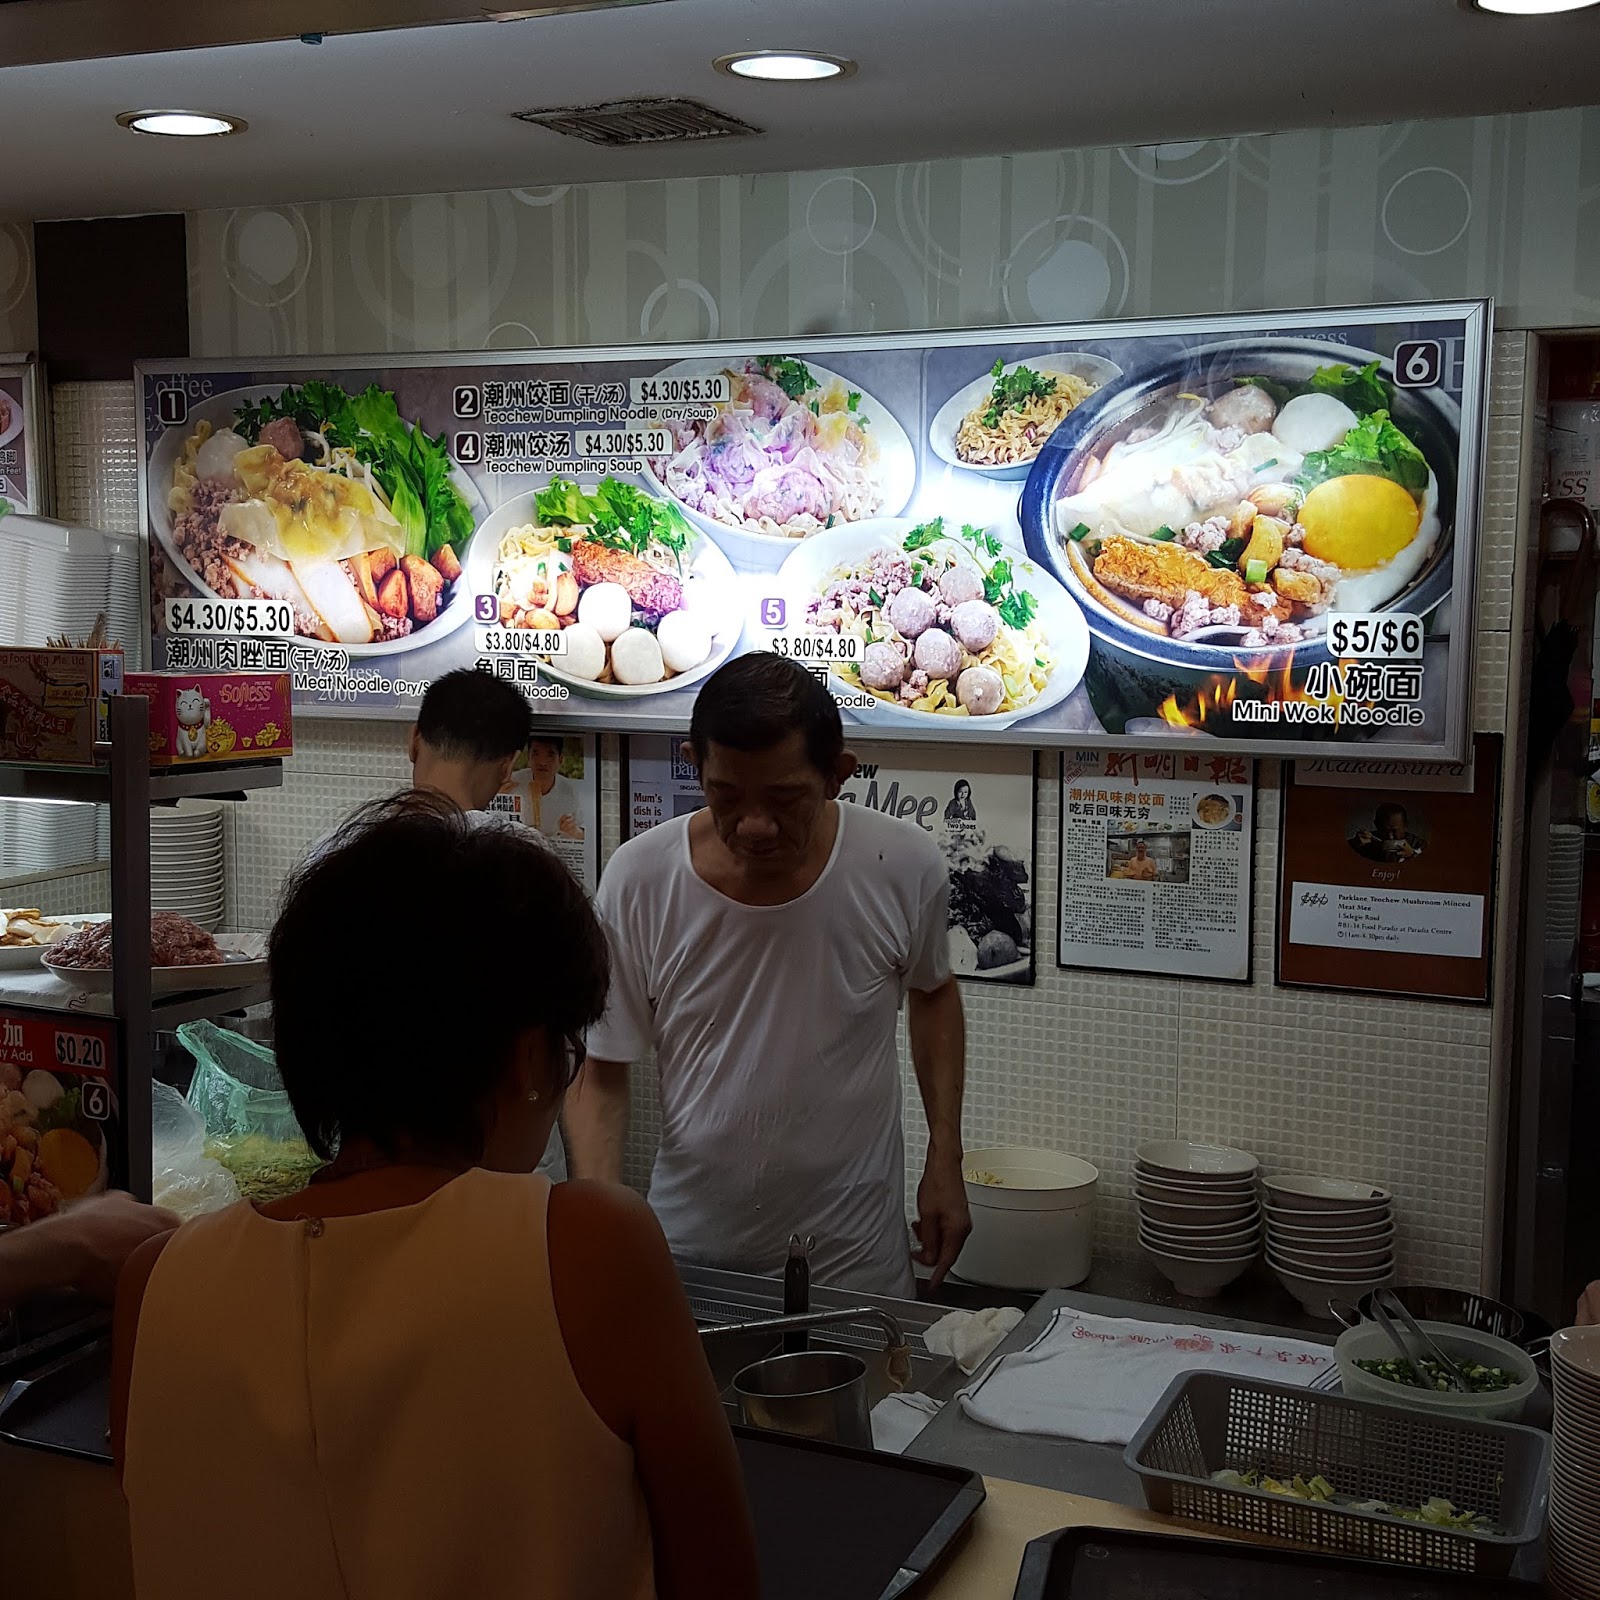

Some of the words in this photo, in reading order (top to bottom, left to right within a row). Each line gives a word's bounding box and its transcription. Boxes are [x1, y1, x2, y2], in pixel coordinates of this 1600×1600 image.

[1406, 347, 1431, 381] 6
[642, 379, 721, 402] $4.30/$5.30
[460, 390, 474, 413] 2
[485, 410, 544, 424] Teochew
[547, 409, 607, 425] Dumpling
[611, 408, 657, 420] Noodle
[662, 407, 719, 421] (Dry/Soup)
[460, 436, 476, 458] 4
[485, 433, 570, 458] 潮州饺汤
[585, 434, 664, 456] $4.30/$5.30
[486, 460, 543, 473] Teochew
[546, 461, 607, 475] Dumpling
[610, 461, 643, 474] Soup
[479, 597, 494, 620] 3
[765, 599, 783, 624] 5
[171, 603, 290, 634] $4.30/$5.30
[486, 632, 560, 652] $3.80/$4.80
[1332, 620, 1420, 656] $5/$6
[772, 638, 857, 659] $3.80/$4.80
[295, 675, 332, 690] Meat
[337, 676, 390, 692] Noodle
[523, 685, 568, 698] Noodle
[1306, 664, 1424, 701] 小碗面
[832, 694, 876, 707] oodle
[1235, 702, 1279, 721] Mini
[1286, 704, 1336, 722] Wok
[1342, 705, 1424, 724] Noodle
[1075, 751, 1099, 762] MIN
[850, 763, 879, 779] ew
[634, 793, 662, 803] Mum's
[864, 780, 938, 832] Mee
[634, 806, 651, 816] dish
[654, 807, 662, 816] is
[1069, 803, 1151, 820] 吃后回味无穷
[634, 818, 652, 829] best
[1371, 868, 1401, 881] Enjoy!
[1338, 894, 1367, 902] Parklane
[1371, 896, 1400, 904] Teochew
[1402, 898, 1440, 906] Mushroom
[1442, 900, 1471, 908] Minced
[1338, 903, 1355, 911] Meat
[1343, 913, 1363, 922] Selegie
[1431, 928, 1453, 936] Centre
[11, 1048, 34, 1062] Add
[57, 1034, 102, 1067] $0.20
[89, 1088, 104, 1115] 6
